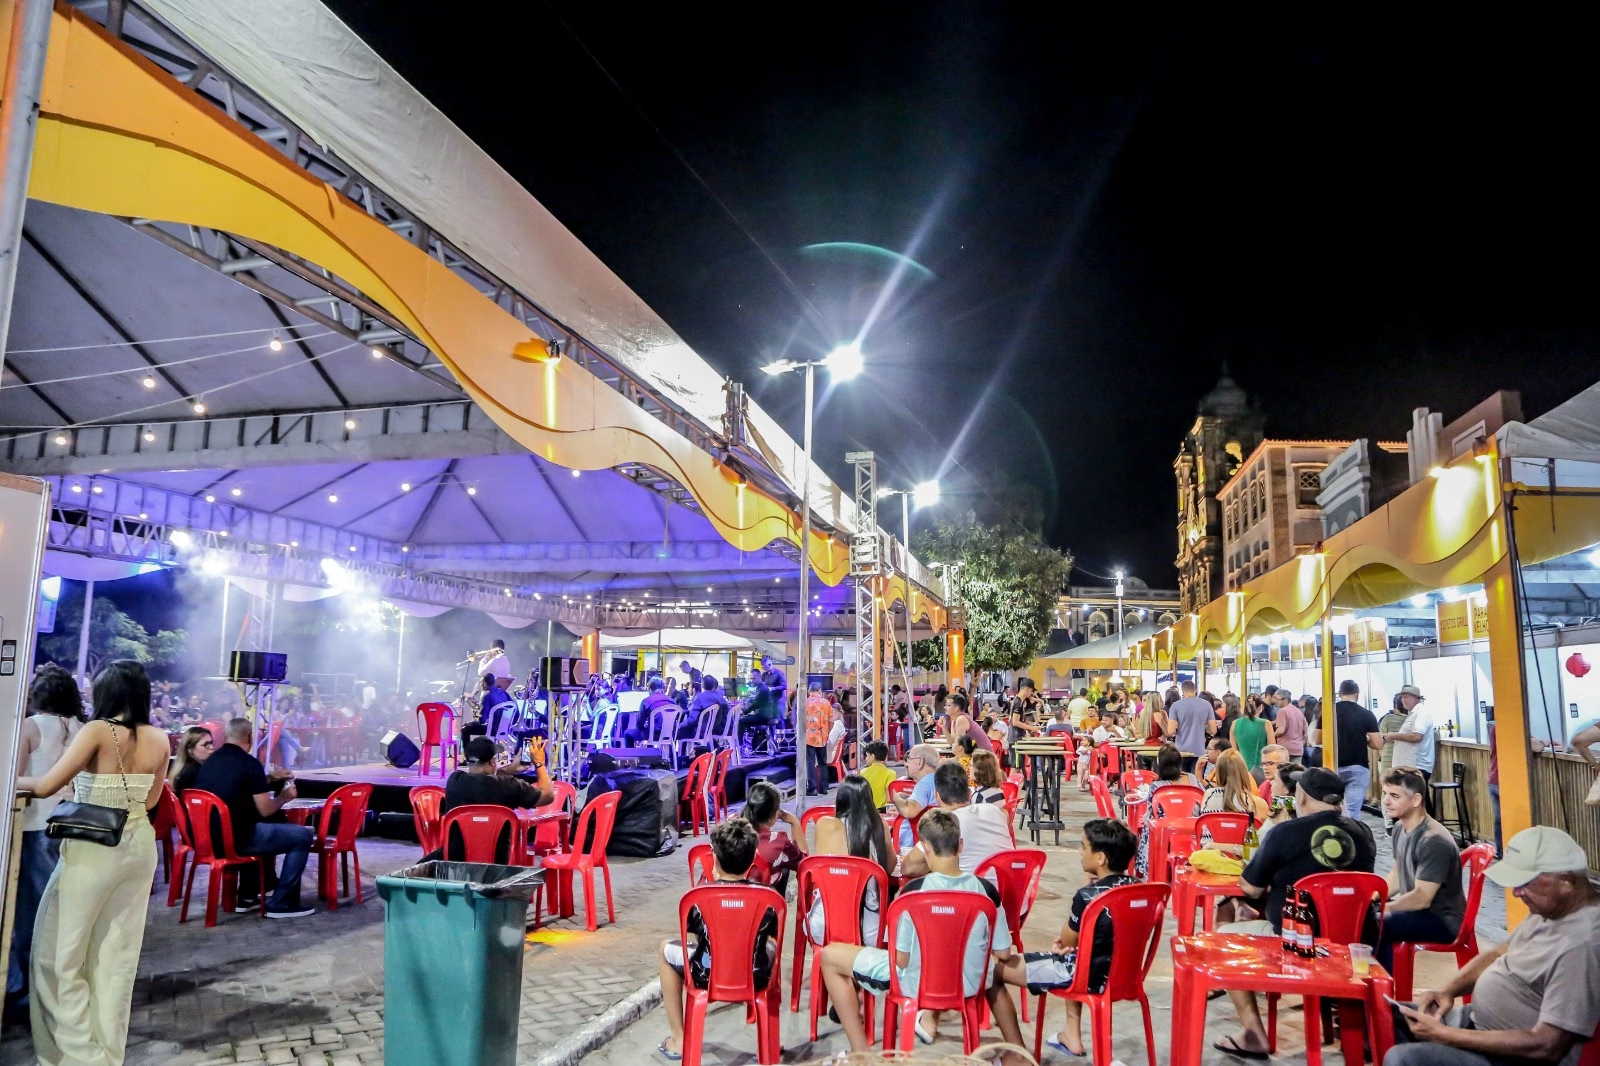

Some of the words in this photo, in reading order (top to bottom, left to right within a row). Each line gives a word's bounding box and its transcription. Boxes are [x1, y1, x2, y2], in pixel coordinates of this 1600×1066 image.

[829, 867, 849, 875] BRAHMA
[721, 899, 744, 908] BRAHMA
[931, 905, 955, 914] BRAHMA
